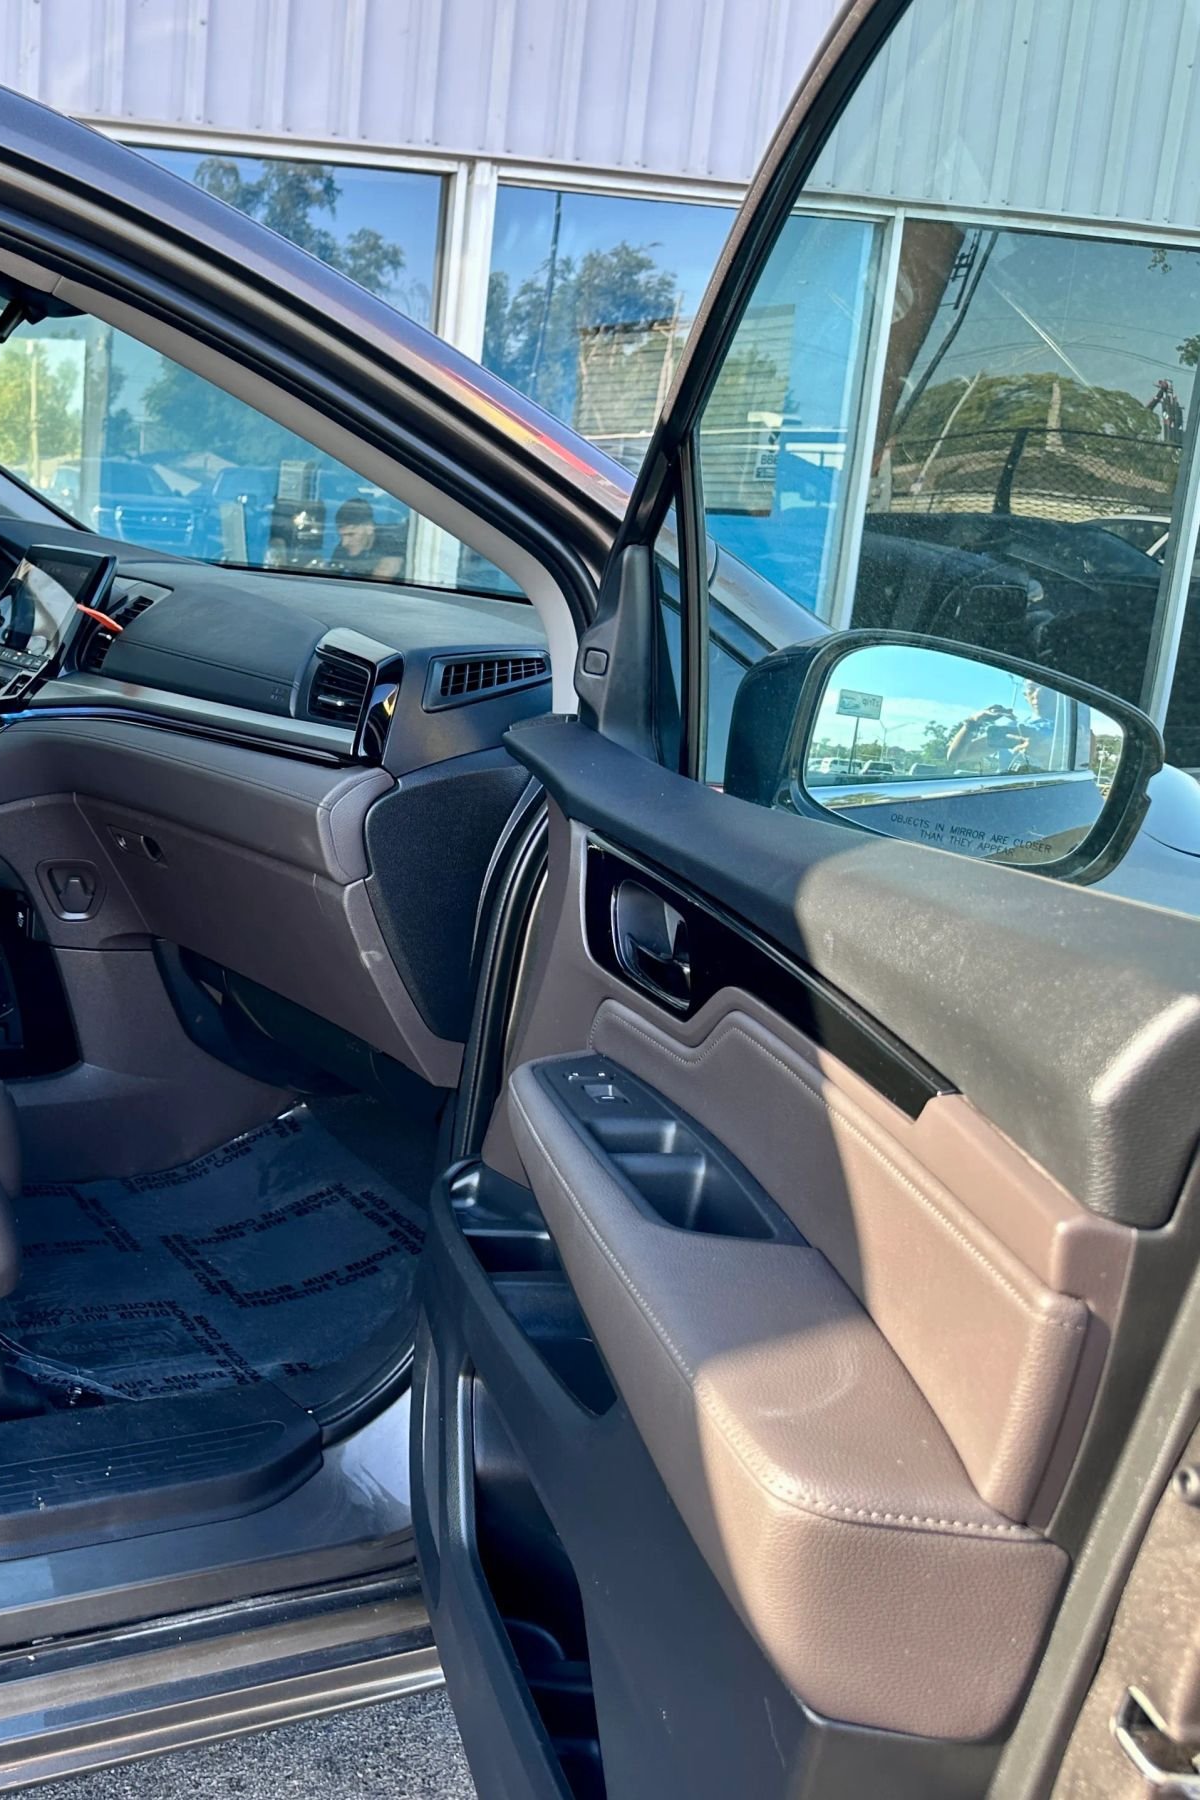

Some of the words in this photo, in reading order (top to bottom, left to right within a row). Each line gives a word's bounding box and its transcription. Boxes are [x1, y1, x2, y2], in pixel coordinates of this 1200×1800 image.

[890, 813, 930, 829] OBJECTS
[935, 822, 945, 832] IN
[950, 825, 986, 840] MIRROR
[990, 834, 1009, 844] ARE
[1013, 838, 1053, 854] CLOSER
[919, 829, 943, 842] THAN
[950, 835, 973, 848] THEY
[977, 842, 1016, 856] APPEAR
[222, 1126, 273, 1155] REMOVE
[139, 1167, 210, 1192] PROTECTIVE
[213, 1146, 253, 1168] COVER
[301, 1270, 340, 1288] MUST
[344, 1243, 400, 1273] REMOVE
[249, 1283, 333, 1307] PROTECTIVE
[335, 1264, 382, 1287] COVER
[111, 1378, 154, 1392] MUST
[162, 1370, 228, 1385] REMOVE
[148, 1381, 202, 1395] COVER
